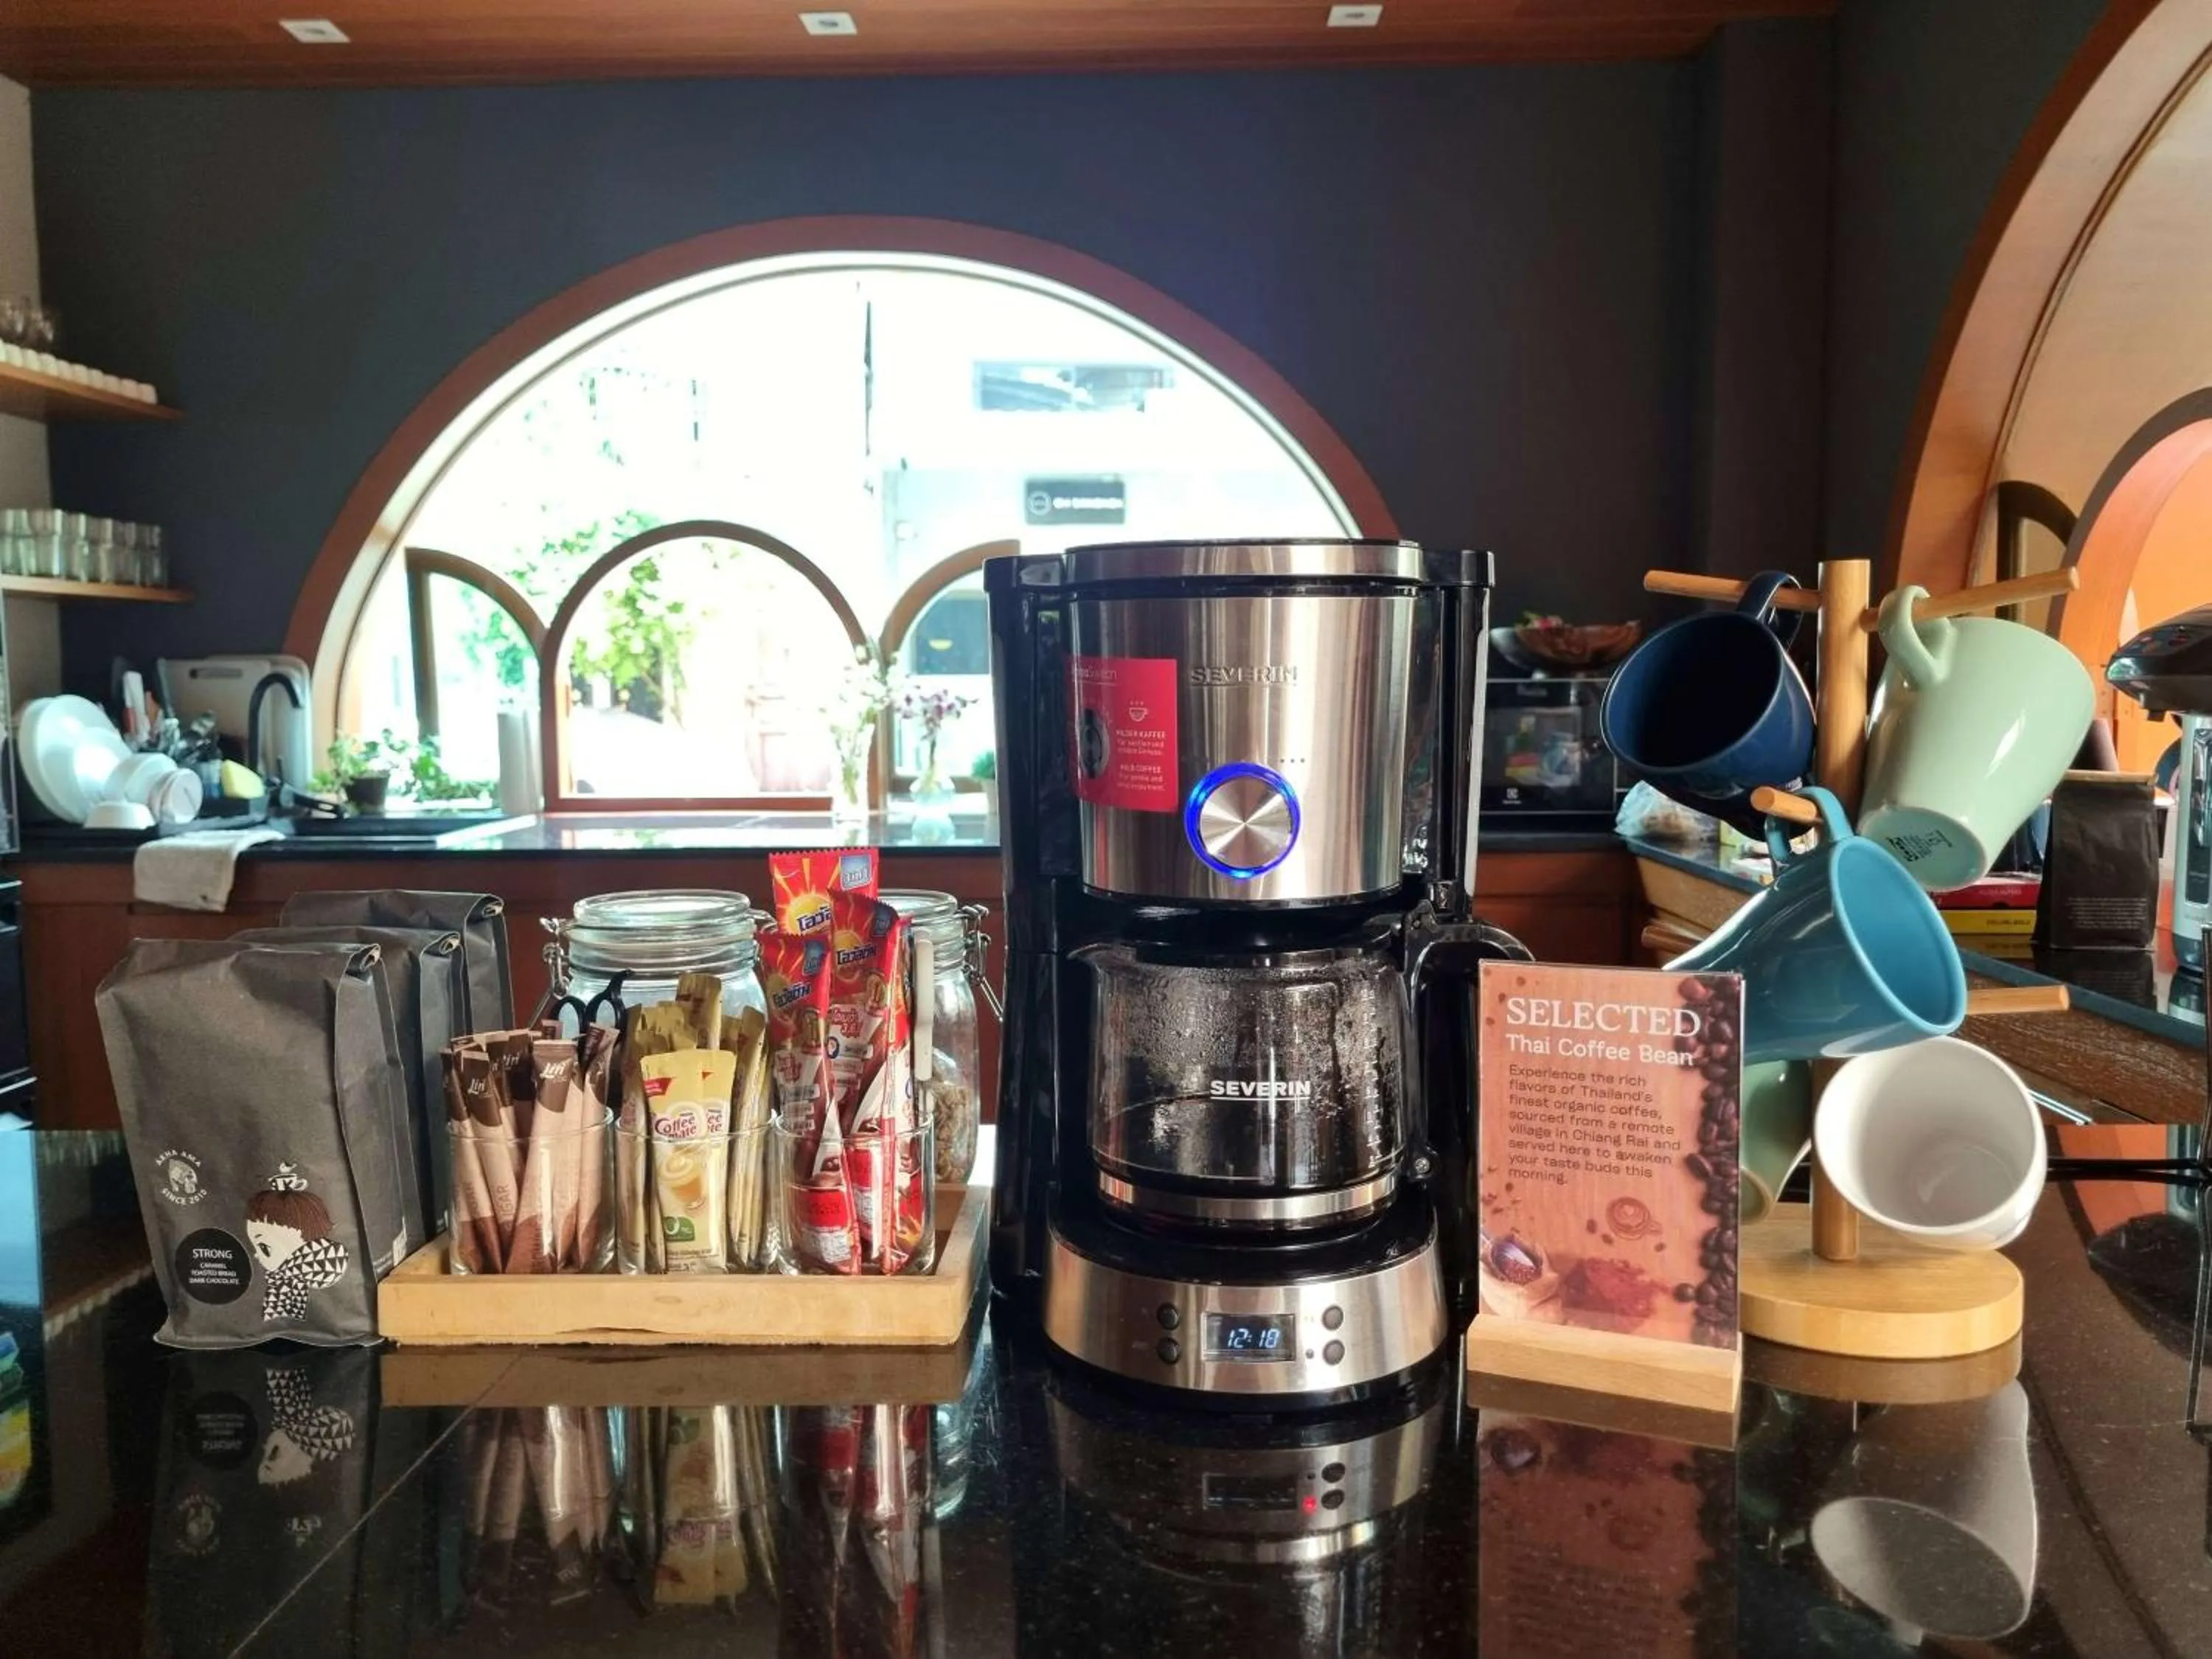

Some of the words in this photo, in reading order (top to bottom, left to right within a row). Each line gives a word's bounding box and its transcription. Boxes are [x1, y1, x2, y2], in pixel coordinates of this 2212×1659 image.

[1191, 666, 1298, 684] SEVERIN
[1506, 998, 1701, 1037] SELECTED
[1506, 1034, 1550, 1055] Thai
[1558, 1037, 1630, 1060] Coffee
[1638, 1046, 1694, 1066] Bean
[1509, 1064, 1586, 1082] Experience
[1590, 1068, 1615, 1085] the
[1618, 1070, 1646, 1086] rich
[1210, 1080, 1310, 1096] SEVERIN
[1509, 1079, 1557, 1094] flavors
[1560, 1082, 1575, 1095] of
[1581, 1084, 1653, 1103] Thailand's
[1509, 1093, 1550, 1108] finest
[1554, 1098, 1605, 1114] organic
[1610, 1103, 1662, 1120] coffee,
[655, 1116, 695, 1136] Coffee
[1509, 1110, 1564, 1124] sourced
[1569, 1113, 1603, 1127] from
[1607, 1119, 1617, 1129] a
[1621, 1120, 1674, 1135] remote
[1509, 1124, 1551, 1140] village
[1555, 1128, 1569, 1140] in
[1573, 1130, 1621, 1148] Chiang
[1626, 1134, 1649, 1148] Rai
[1653, 1137, 1681, 1151] and
[1509, 1139, 1556, 1154] served
[1559, 1141, 1590, 1156] here
[1596, 1147, 1611, 1158] to
[1615, 1150, 1672, 1164] awaken
[1508, 1169, 1568, 1185] morning.
[1509, 1155, 1539, 1169] your
[1543, 1157, 1580, 1170] taste
[1585, 1160, 1620, 1175] buds
[1625, 1164, 1652, 1178] this
[161, 1188, 186, 1205] SINCE
[192, 1248, 233, 1259] STRONG
